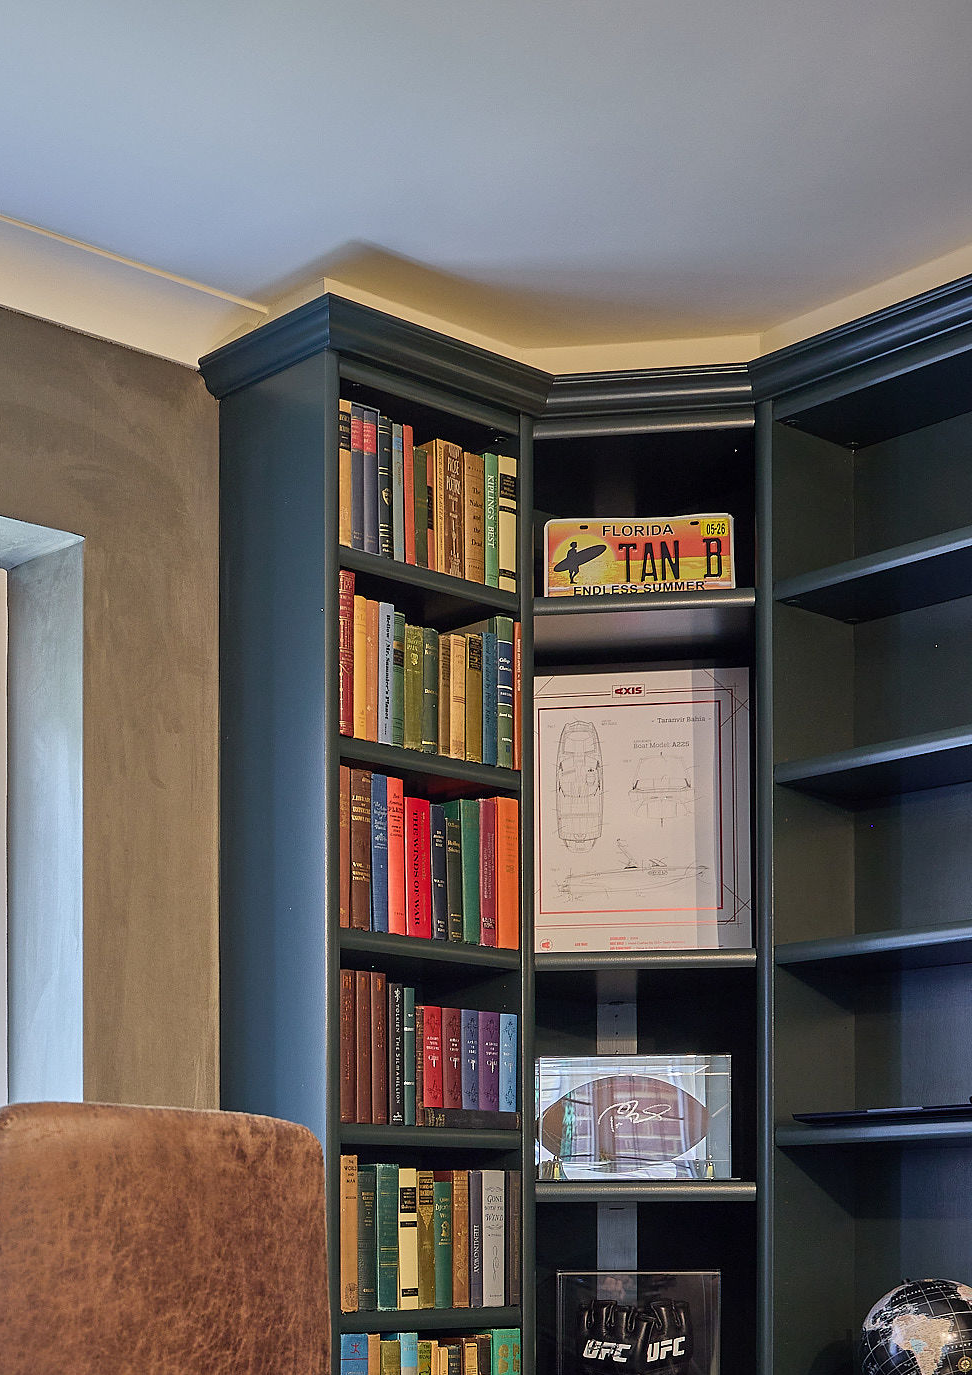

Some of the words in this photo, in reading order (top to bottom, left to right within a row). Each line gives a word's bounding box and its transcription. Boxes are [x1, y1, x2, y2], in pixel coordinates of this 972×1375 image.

[602, 524, 674, 537] FLORIDA
[618, 540, 679, 583] TAN
[703, 537, 723, 579] B
[573, 584, 638, 597] ENDLESS
[643, 581, 705, 594] SUMMER
[614, 686, 642, 695] AXIS
[413, 881, 419, 897] OF
[583, 1339, 632, 1363] UFC
[647, 1336, 686, 1363] UFC
